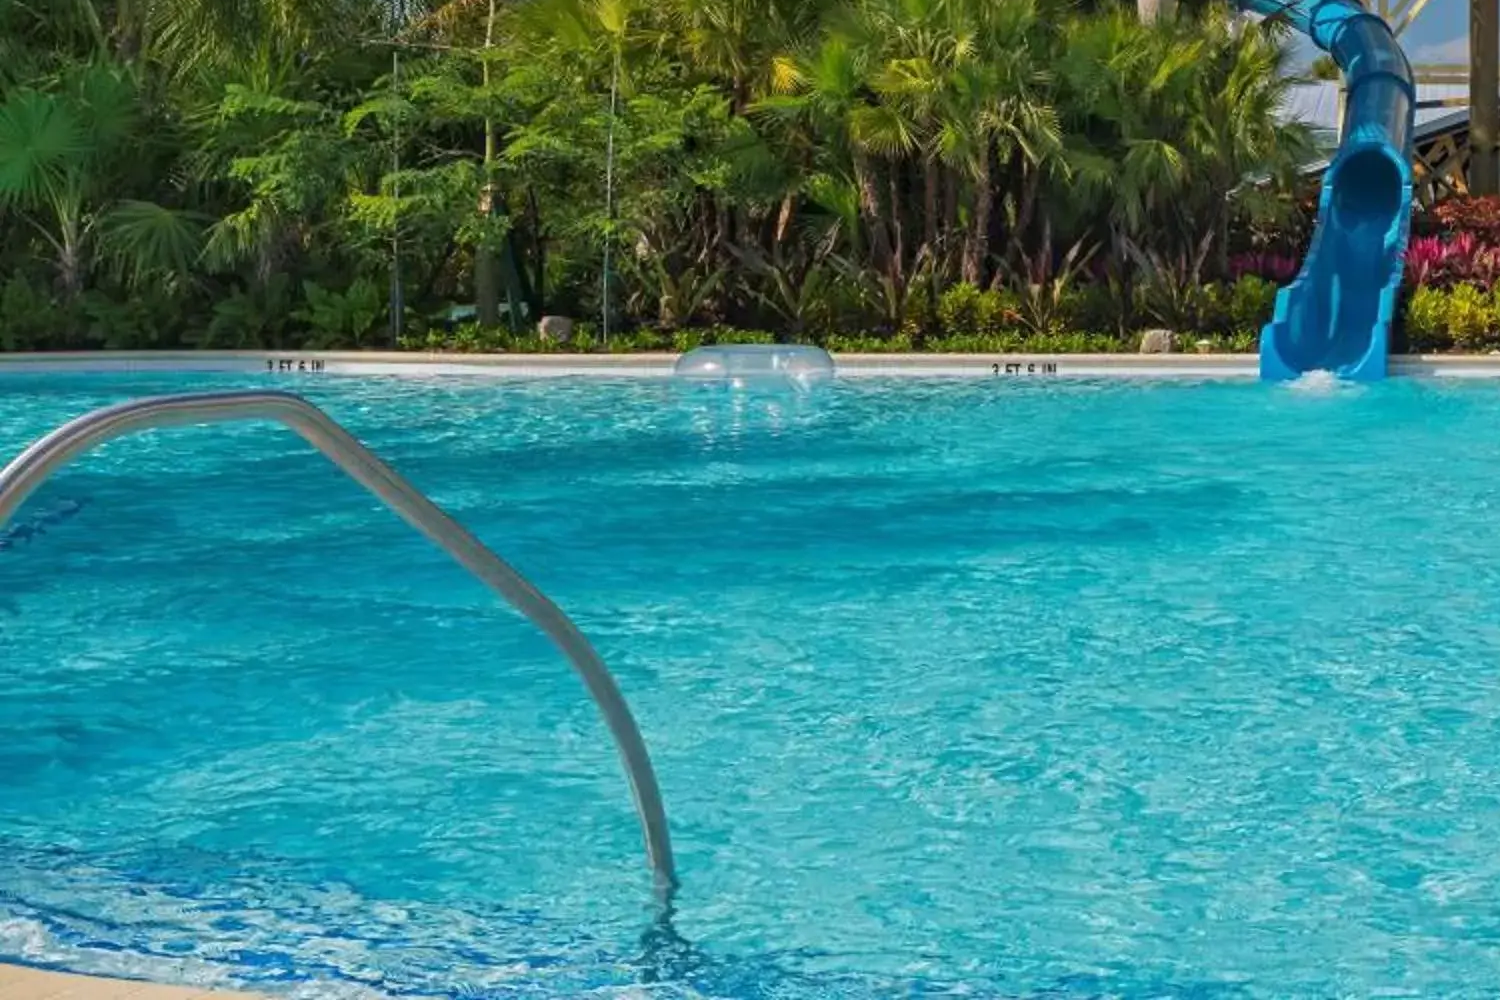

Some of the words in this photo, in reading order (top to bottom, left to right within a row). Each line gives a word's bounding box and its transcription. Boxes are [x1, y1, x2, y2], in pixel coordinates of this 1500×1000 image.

[279, 359, 292, 371] FT
[311, 359, 325, 371] IN
[1005, 363, 1021, 376] FT
[1042, 363, 1057, 375] IN
